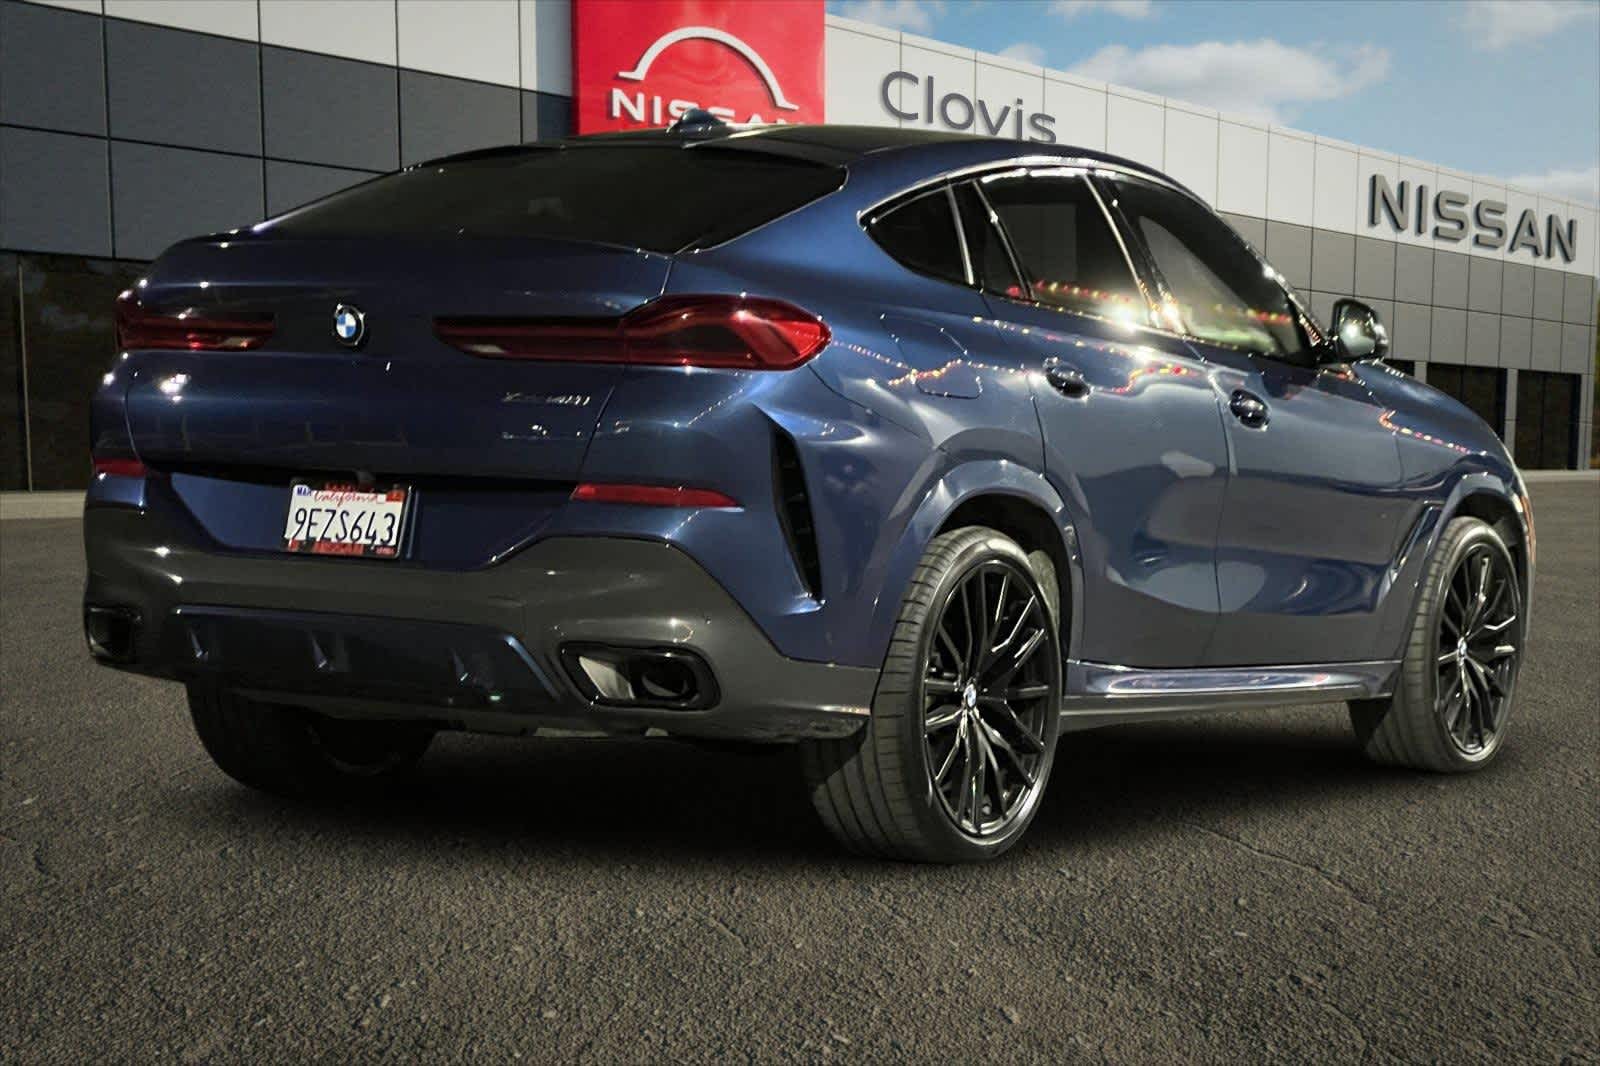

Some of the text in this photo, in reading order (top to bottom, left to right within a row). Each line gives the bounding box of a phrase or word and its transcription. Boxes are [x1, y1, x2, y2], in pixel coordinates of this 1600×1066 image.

[881, 70, 1057, 143] Clovis
[1368, 173, 1577, 263] NISSAN
[291, 507, 396, 545] 9EZS643
